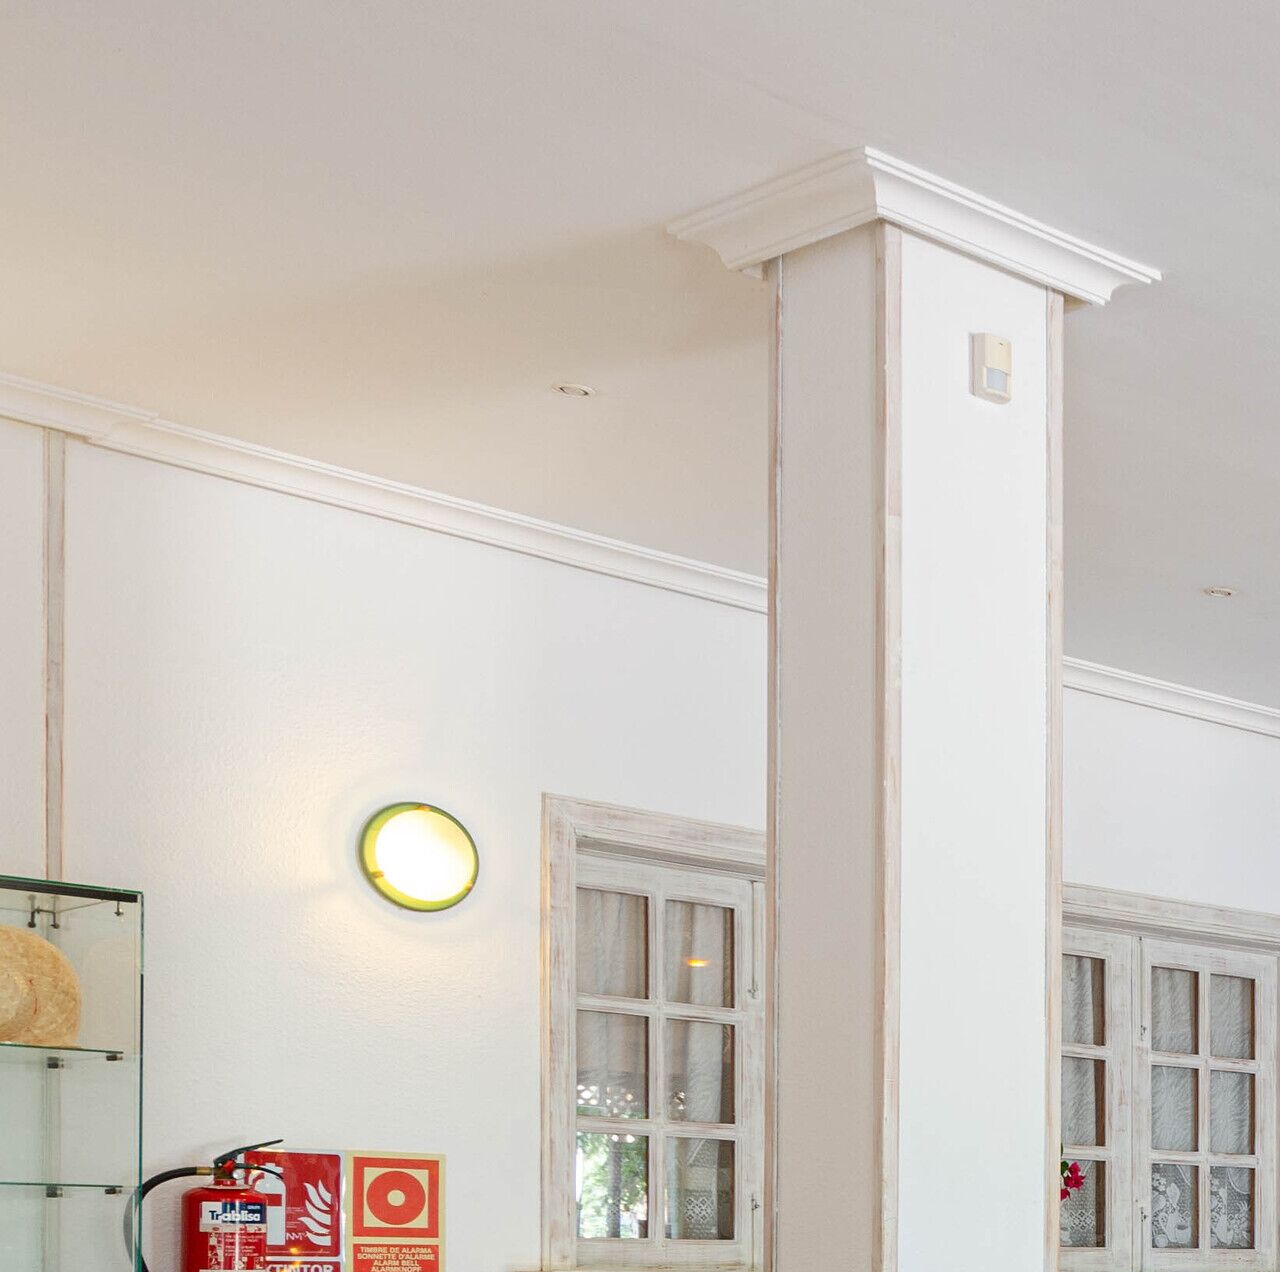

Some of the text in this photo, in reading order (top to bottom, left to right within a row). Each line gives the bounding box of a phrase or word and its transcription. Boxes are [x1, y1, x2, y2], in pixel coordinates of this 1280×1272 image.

[208, 1209, 261, 1222] Trablisa
[360, 1246, 388, 1254] TIMBRE
[389, 1246, 400, 1254] DE
[398, 1253, 436, 1261] D'ALARME
